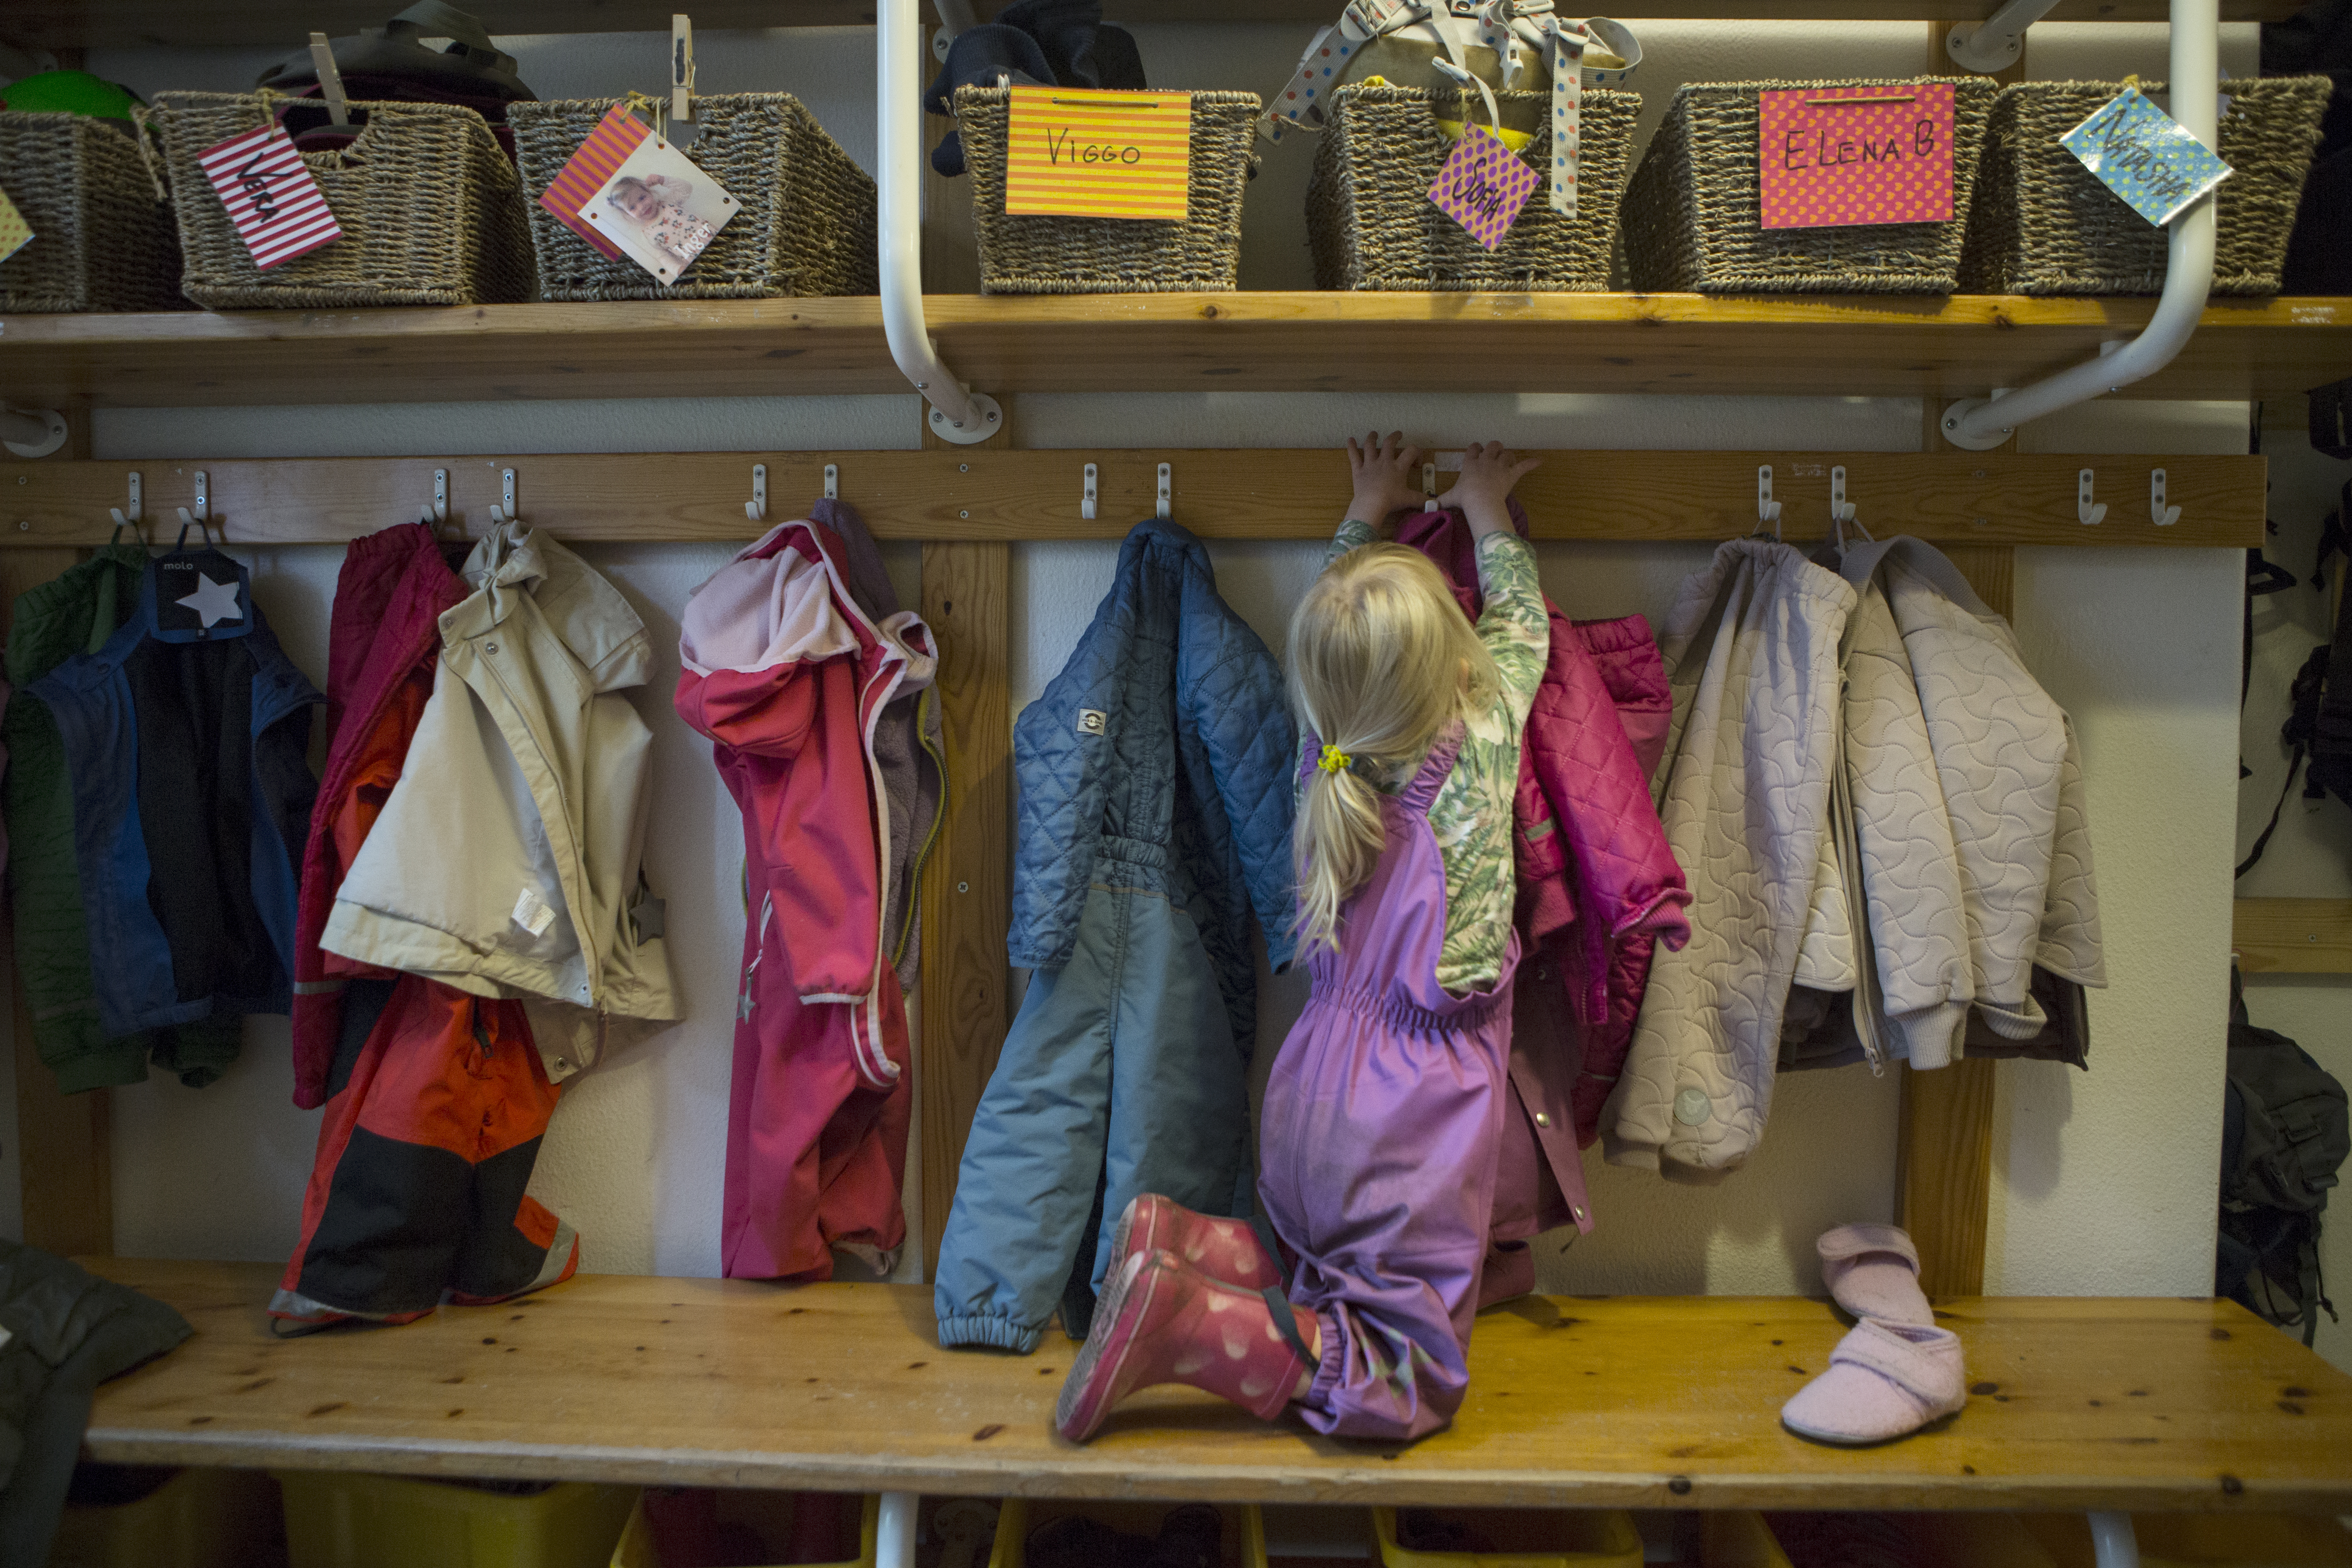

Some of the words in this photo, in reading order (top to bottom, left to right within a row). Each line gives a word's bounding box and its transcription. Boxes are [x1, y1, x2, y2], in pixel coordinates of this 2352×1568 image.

[1785, 130, 1900, 171] ELENA
[1914, 119, 1934, 156] B
[2086, 108, 2192, 203] NATASHA
[674, 223, 711, 260] Inger
[164, 562, 193, 570] molo
